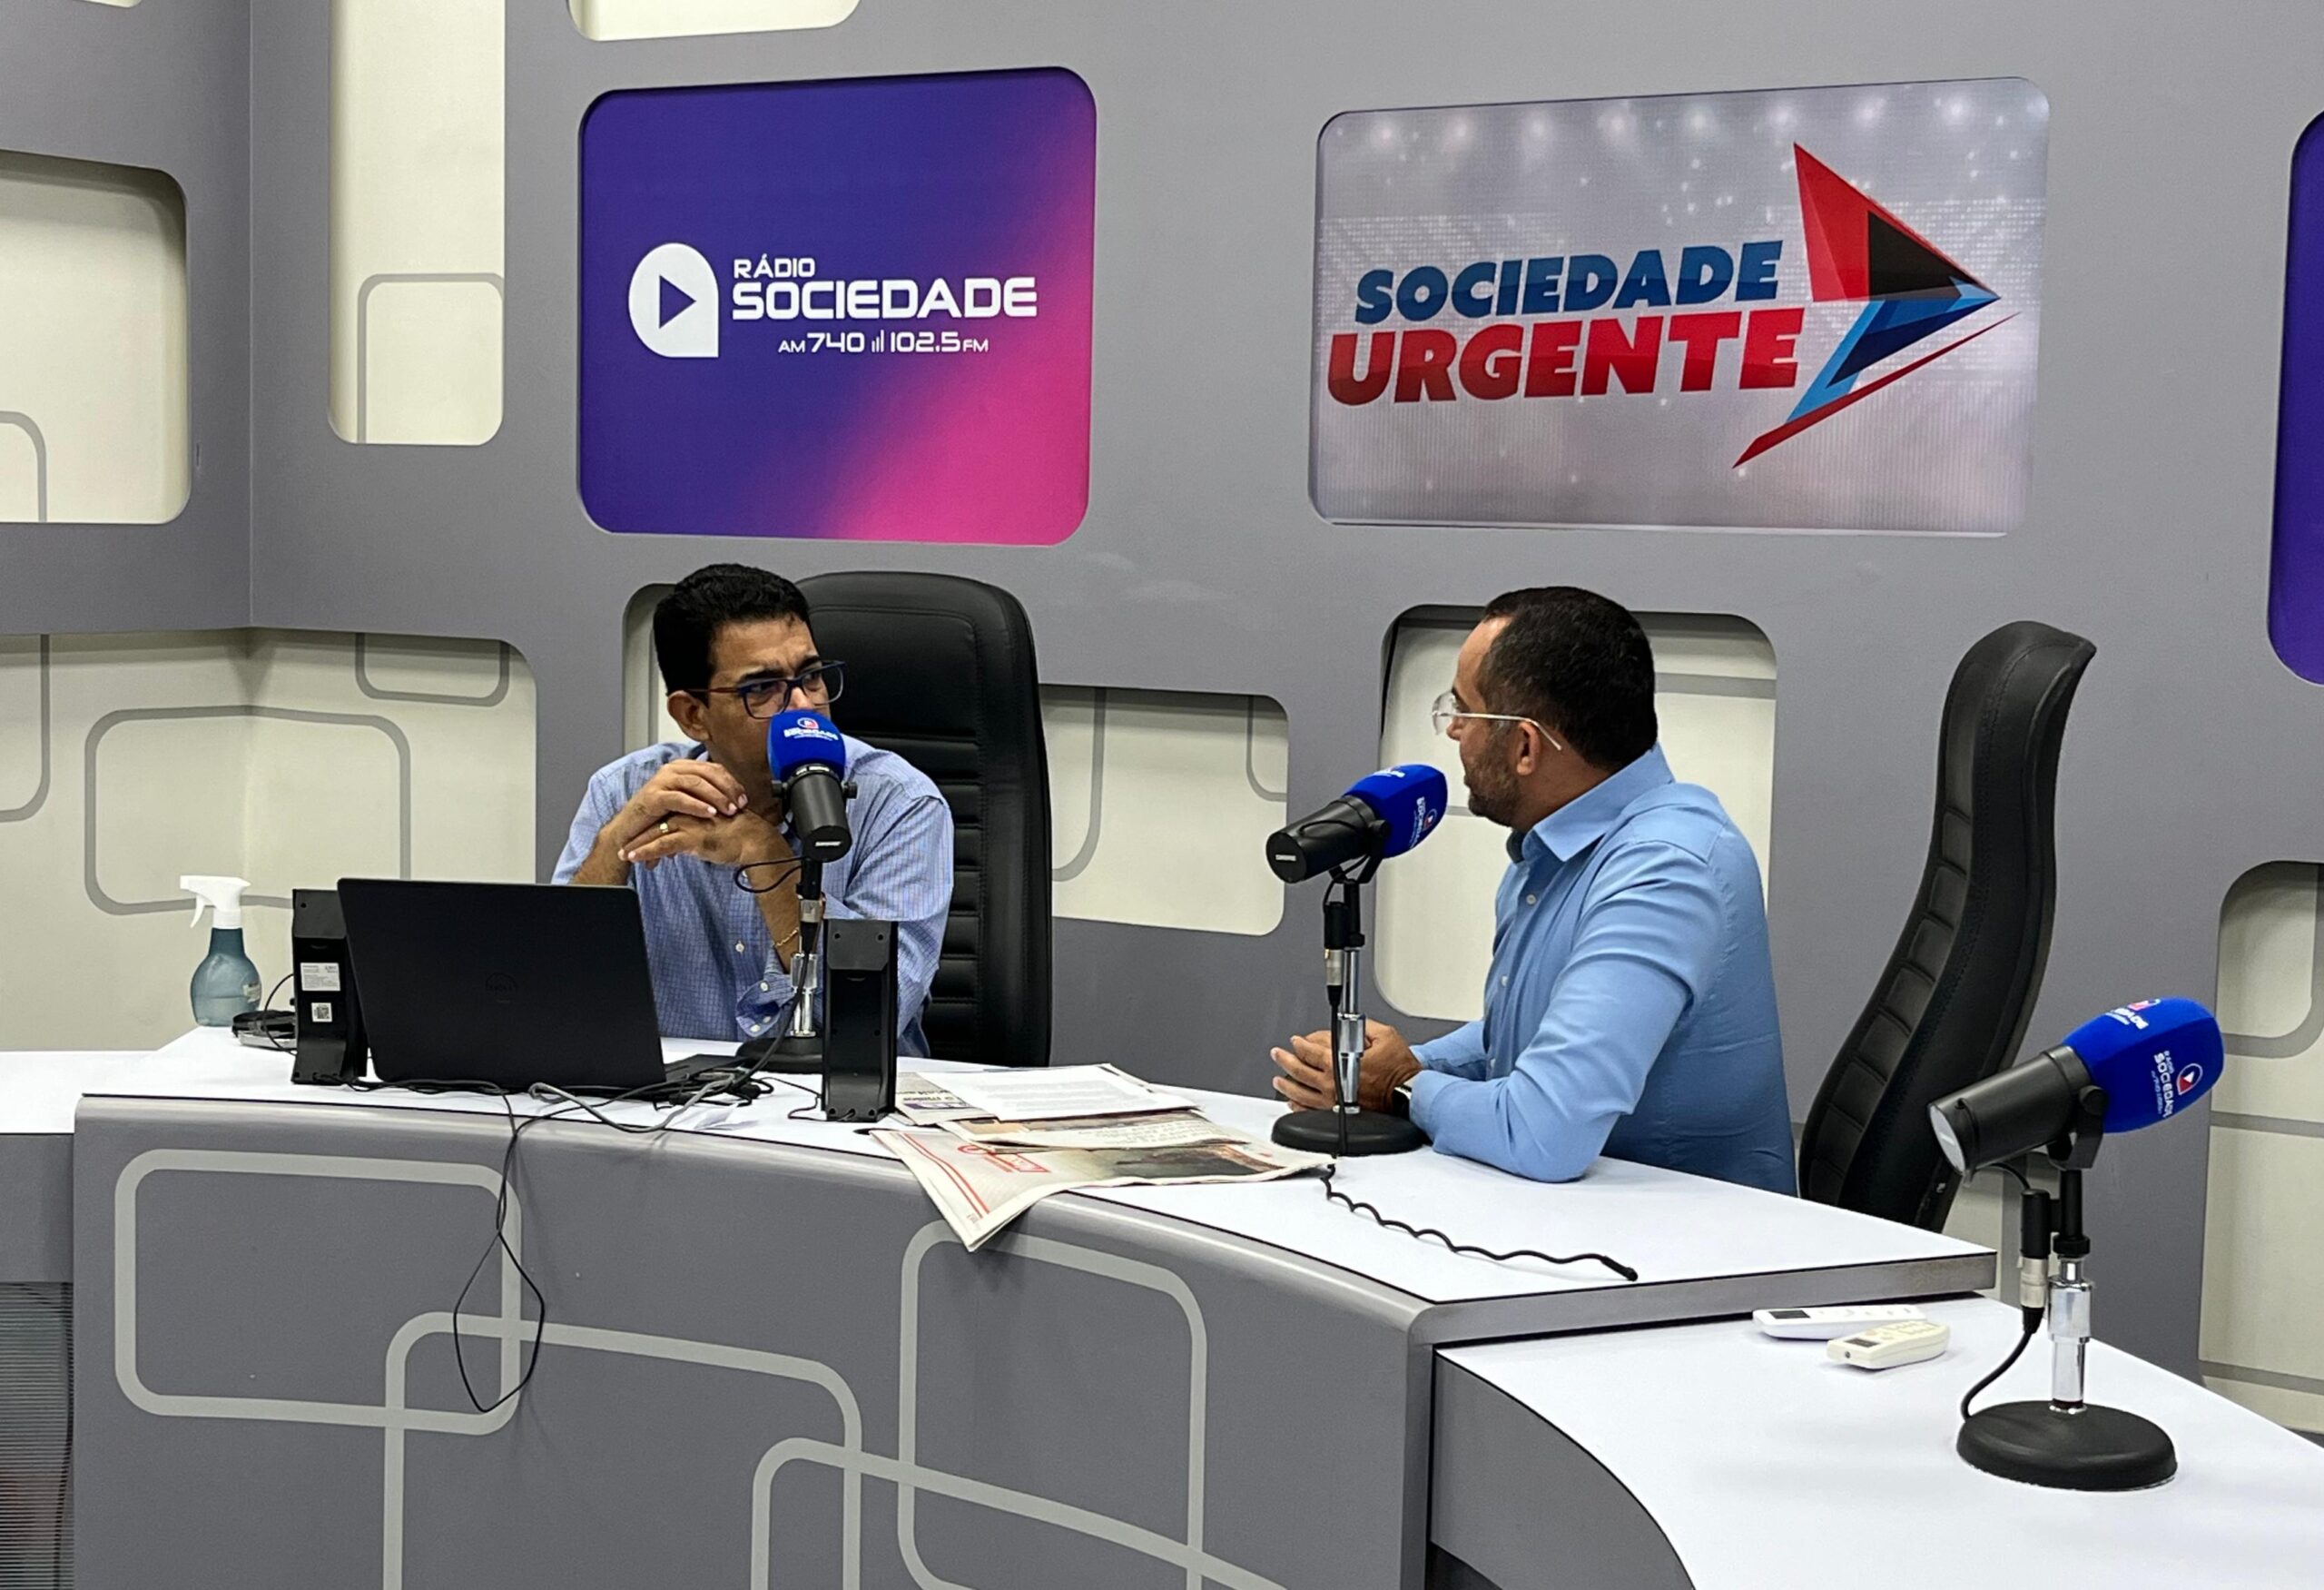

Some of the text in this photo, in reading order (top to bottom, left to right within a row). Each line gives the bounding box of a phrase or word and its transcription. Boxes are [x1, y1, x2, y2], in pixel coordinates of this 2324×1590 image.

[734, 253, 816, 279] RÁDIO
[1355, 240, 1784, 324] SOCIEDADE
[732, 277, 1038, 321] SOCIEDADE
[1328, 306, 1806, 405] URGENTE
